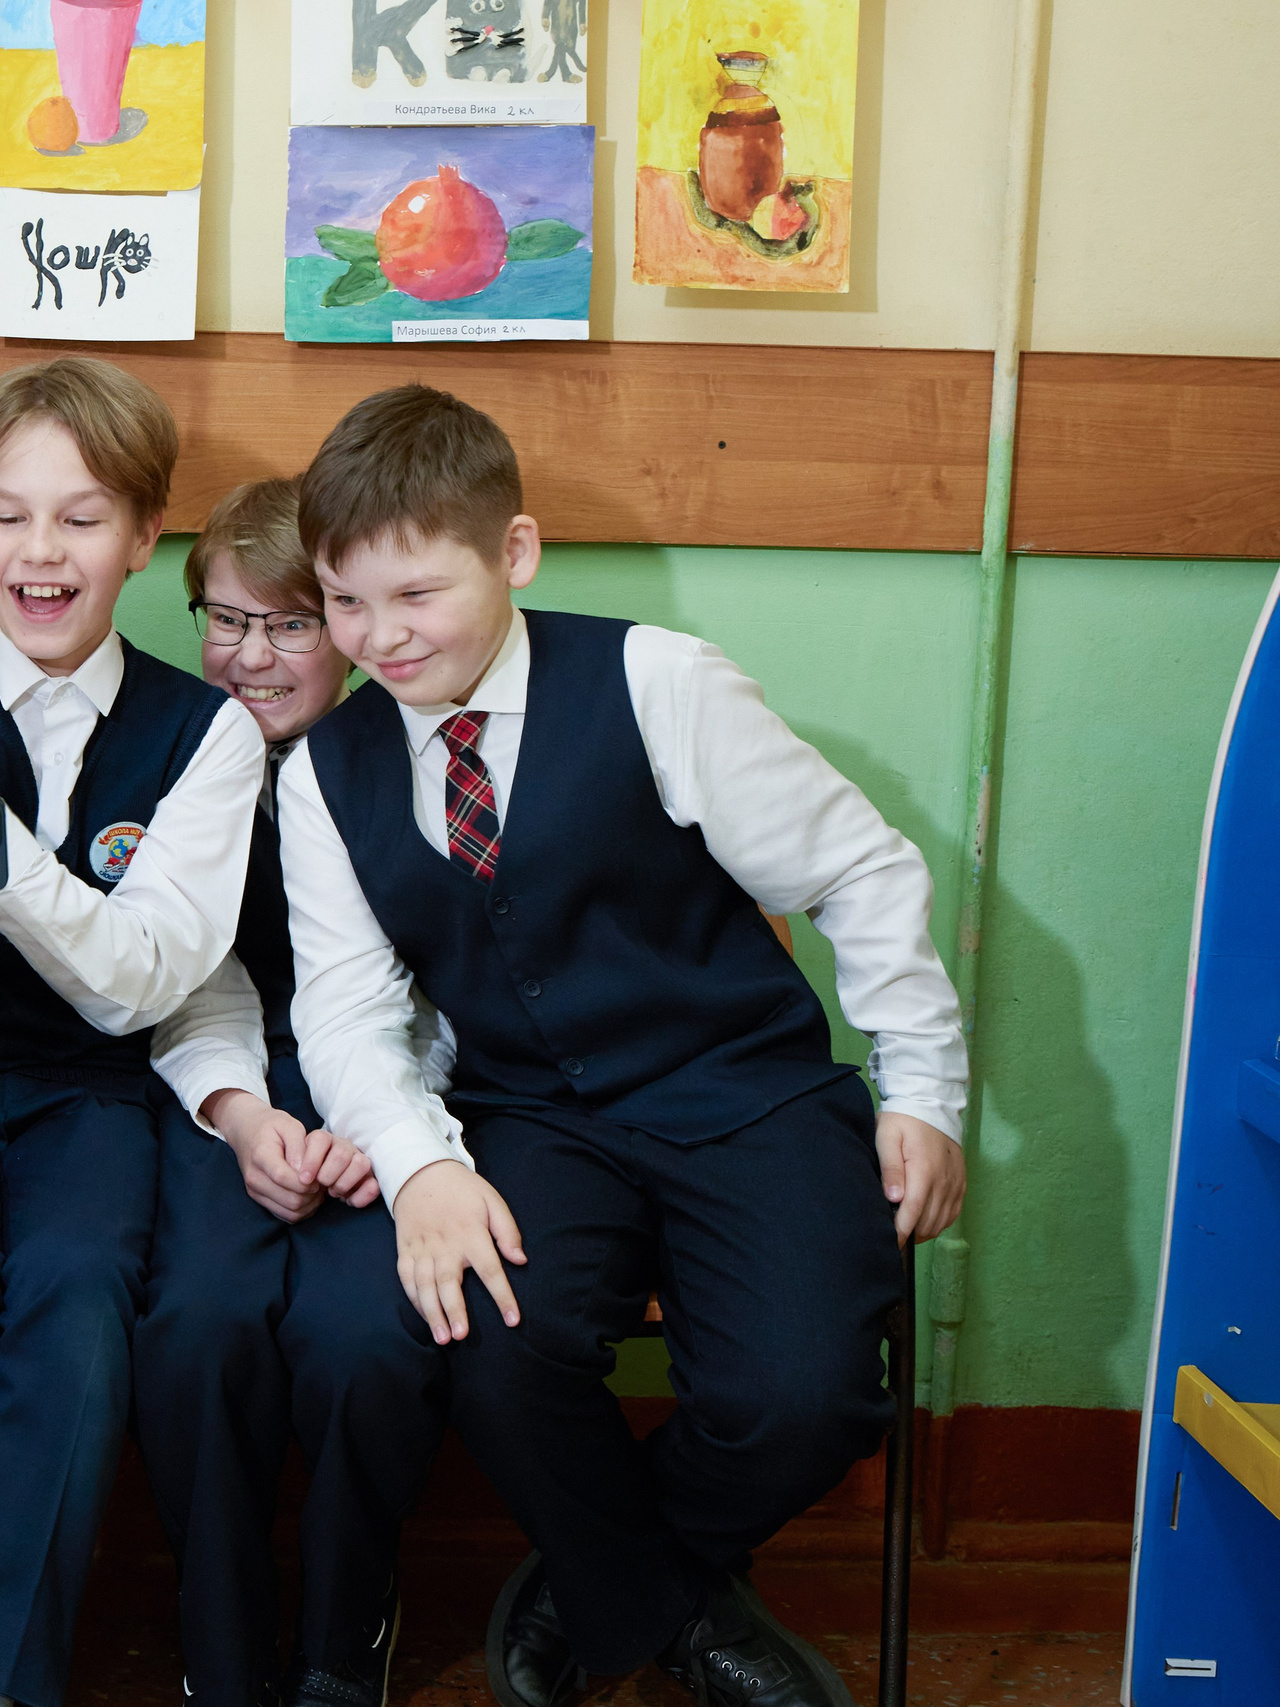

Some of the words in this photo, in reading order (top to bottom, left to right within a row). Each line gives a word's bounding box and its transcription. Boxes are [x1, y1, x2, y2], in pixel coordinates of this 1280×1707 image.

[395, 104, 467, 117] Кондратьева
[471, 105, 496, 115] Вика
[508, 106, 516, 116] 2
[397, 325, 458, 337] Марышева
[461, 325, 497, 337] София
[503, 325, 510, 334] 2
